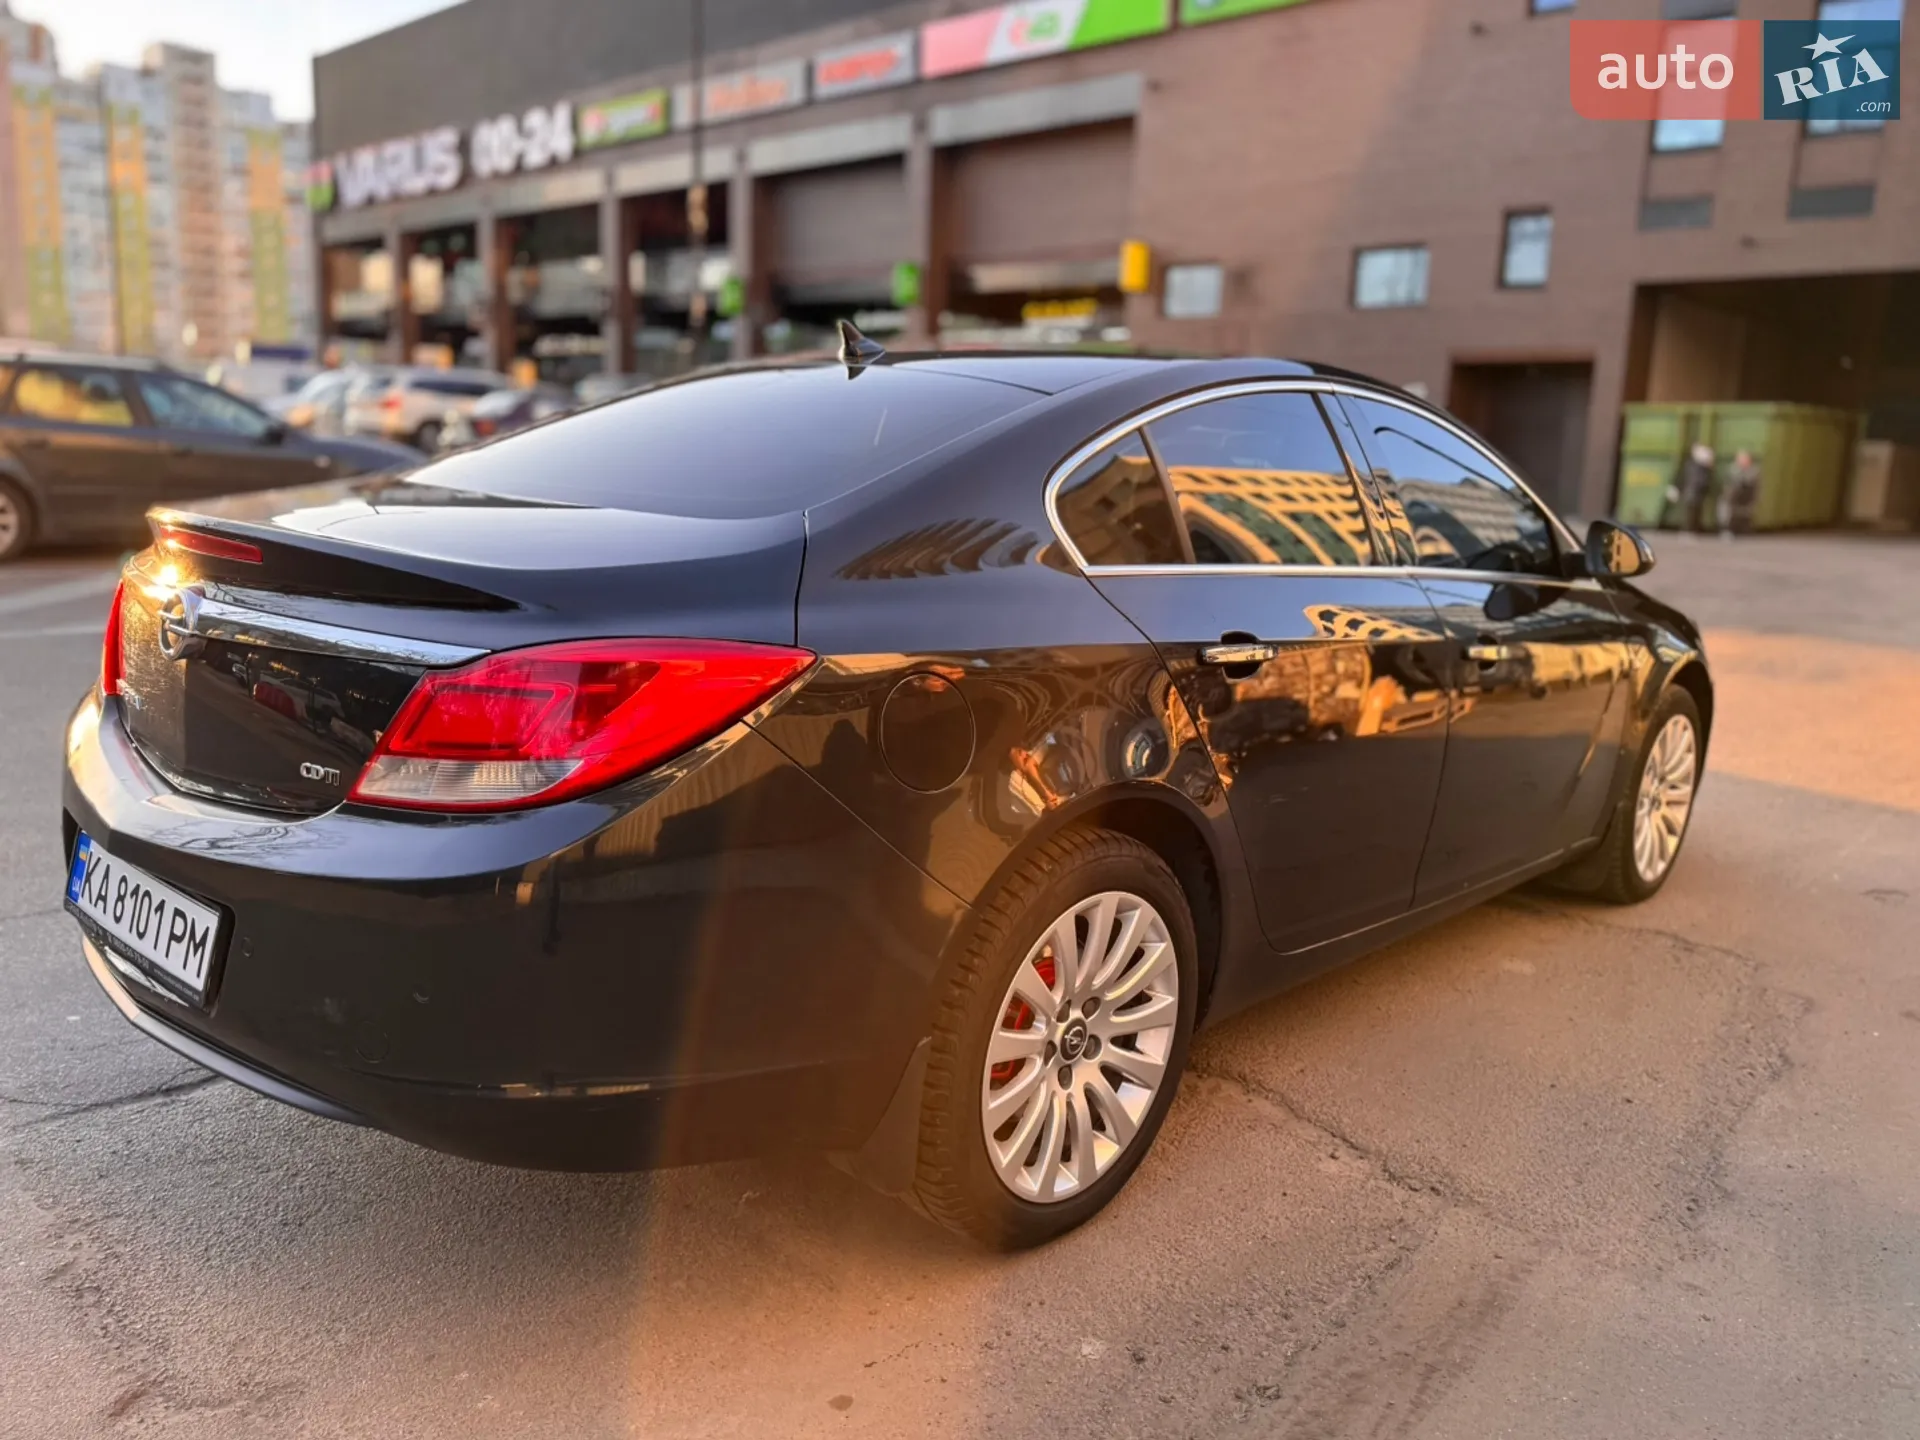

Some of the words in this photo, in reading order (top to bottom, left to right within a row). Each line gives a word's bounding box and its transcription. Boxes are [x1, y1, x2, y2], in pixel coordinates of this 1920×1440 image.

[336, 125, 463, 208] VARUS
[300, 761, 340, 787] CDTI
[81, 850, 111, 915] KA
[113, 874, 167, 951] 8101
[165, 905, 210, 978] PM
